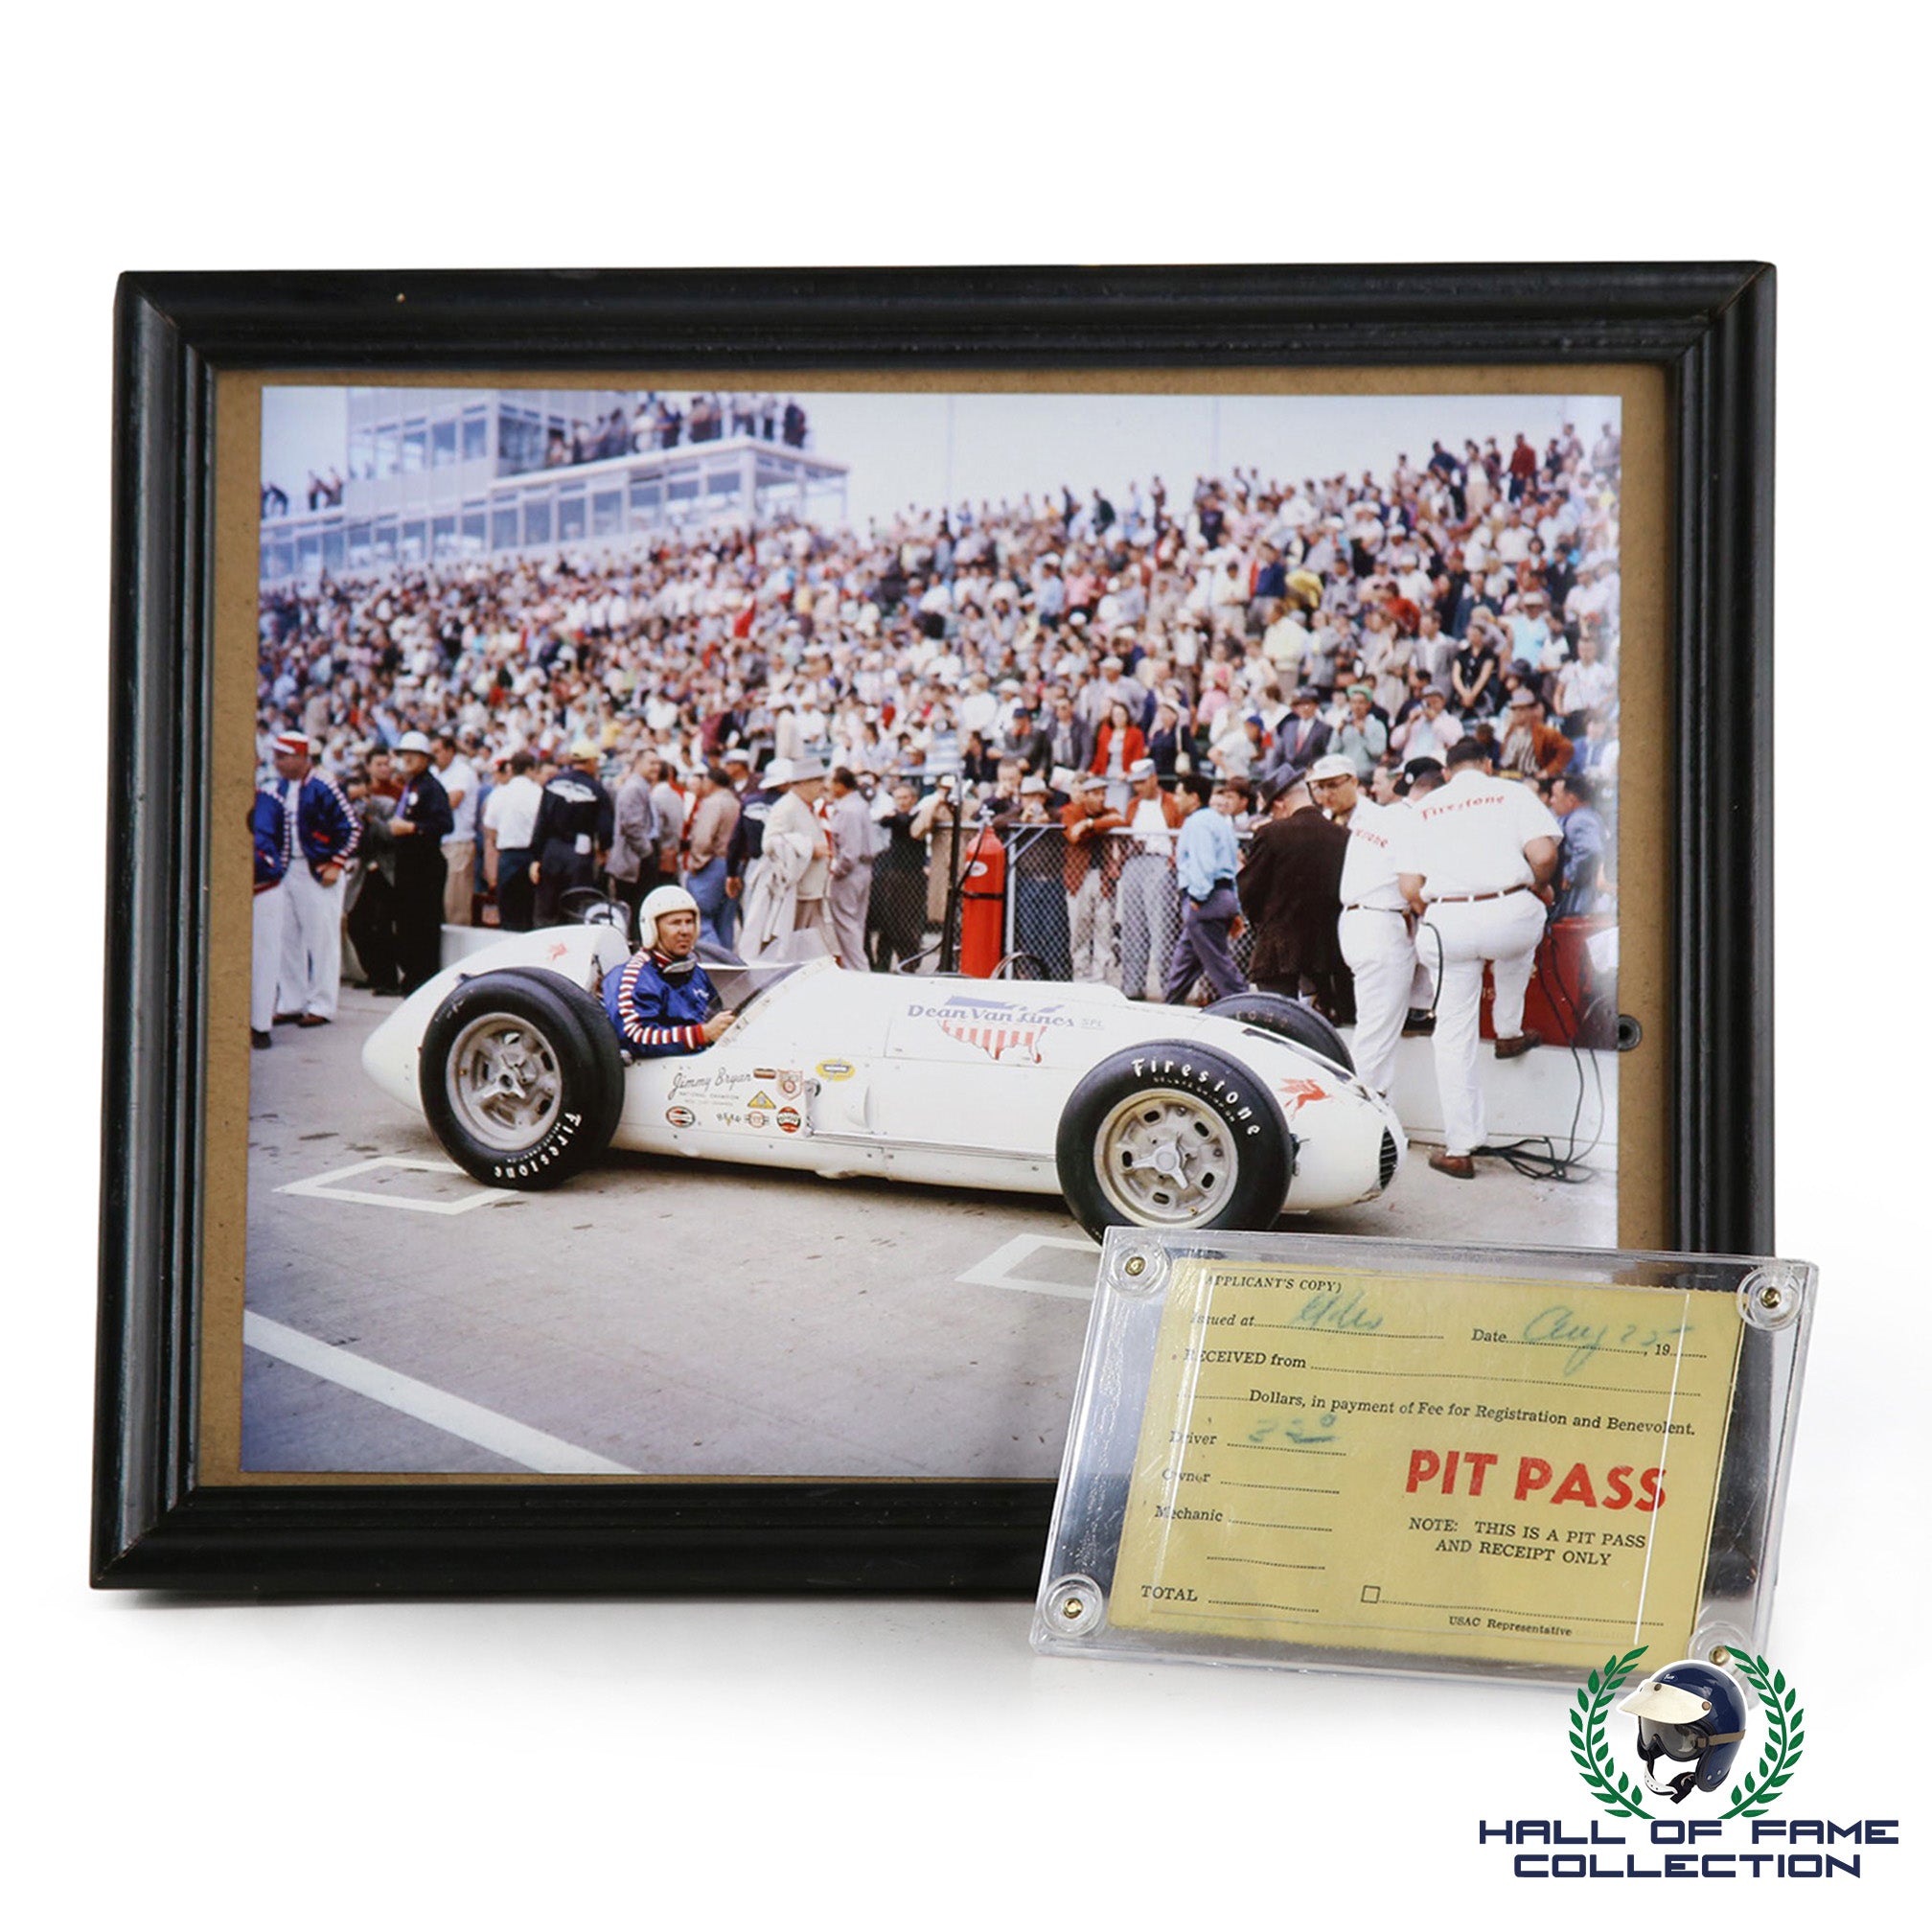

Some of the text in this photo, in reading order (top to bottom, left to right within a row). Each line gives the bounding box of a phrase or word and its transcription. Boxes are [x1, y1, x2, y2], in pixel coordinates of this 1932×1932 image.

[968, 1008, 1012, 1023] Van
[1131, 1057, 1261, 1136] Firestone
[1240, 1314, 1254, 1326] at
[1472, 1328, 1507, 1343] Date
[1270, 1353, 1306, 1368] from
[1249, 1390, 1306, 1408] Dollars,
[1311, 1395, 1326, 1408] in
[1330, 1399, 1394, 1416] payment
[1398, 1401, 1414, 1414] of
[1418, 1402, 1443, 1414] Fee
[1448, 1403, 1470, 1416] for
[1475, 1405, 1568, 1425] Registration
[1573, 1416, 1601, 1429] and
[1405, 1449, 1668, 1512] PIT PASS
[1409, 1517, 1646, 1549] NOTE: THIS IS A PIT PASS
[1435, 1539, 1612, 1566] AND RECEIPT ONLY
[1140, 1585, 1198, 1602] TOTAL
[1449, 1616, 1482, 1627] USAC
[1486, 1619, 1573, 1638] Representative
